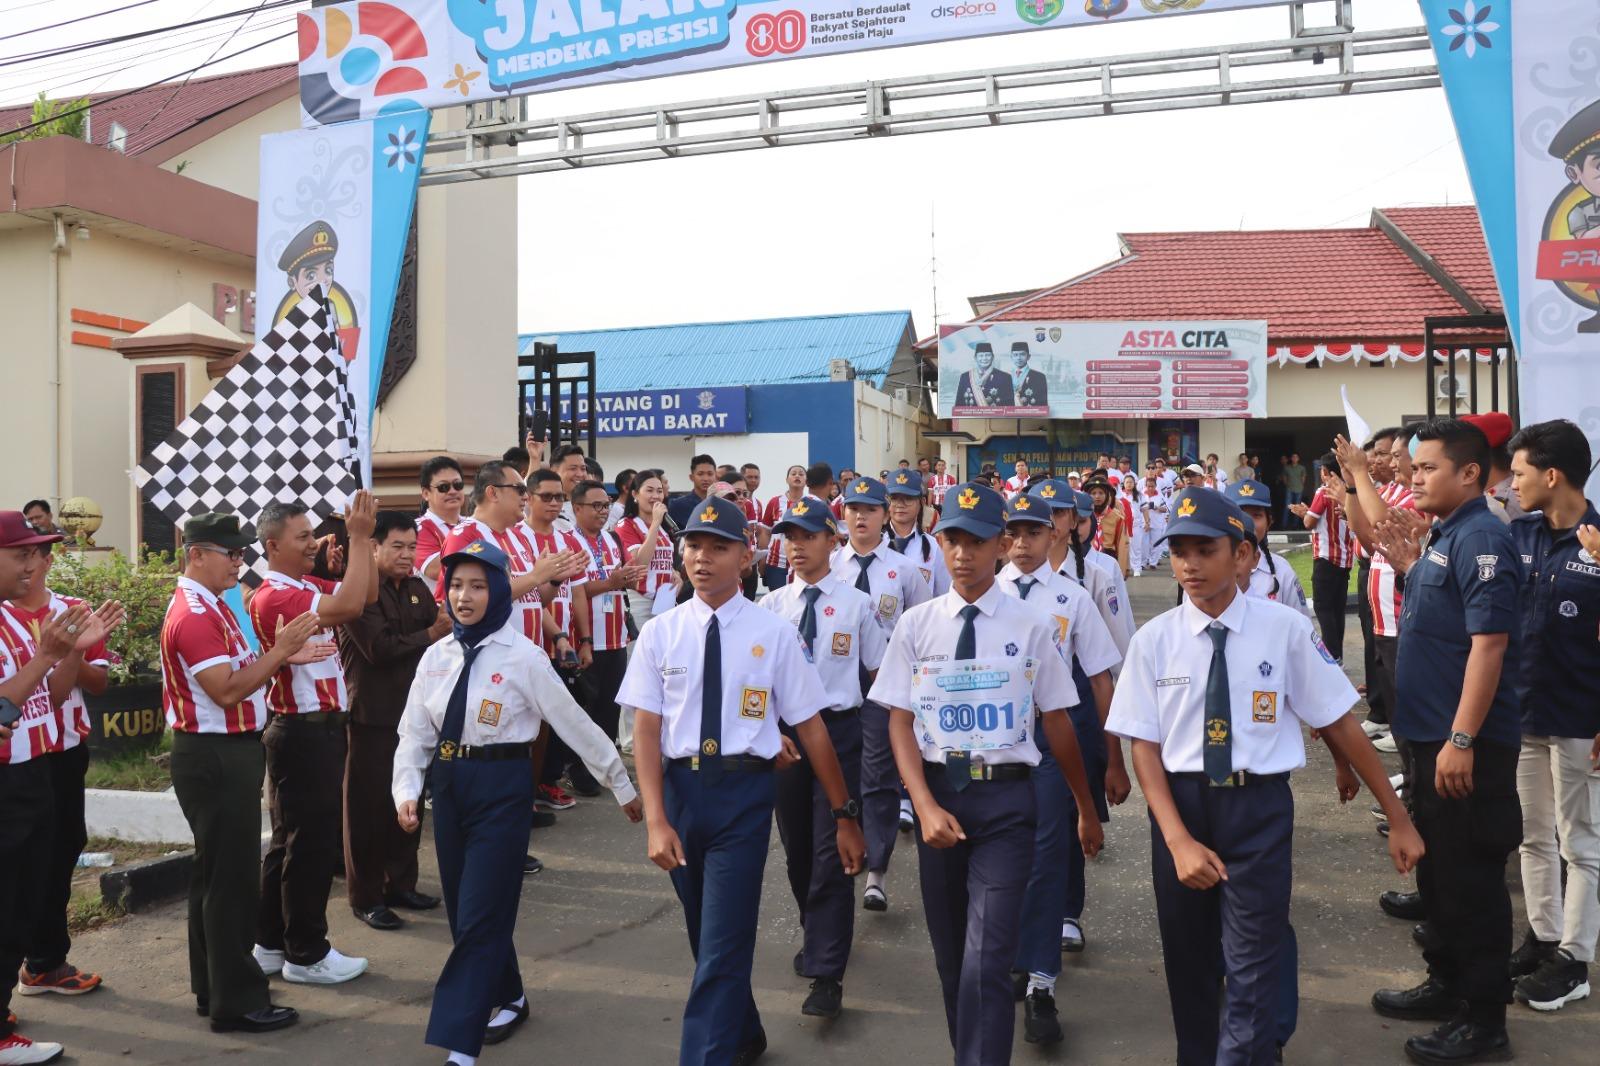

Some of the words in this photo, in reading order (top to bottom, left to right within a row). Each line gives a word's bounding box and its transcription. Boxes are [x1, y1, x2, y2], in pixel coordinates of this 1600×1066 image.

[810, 10, 854, 22] Bersatu
[857, 2, 911, 17] Berdaulat
[931, 1, 997, 18] dispora
[746, 9, 806, 57] 80
[811, 22, 848, 35] Rakyat
[851, 15, 905, 30] Sejahtera
[497, 38, 611, 76] MERDEKA
[619, 16, 718, 52] PRESISI
[811, 32, 865, 45] Indonesia
[868, 28, 893, 39] Maju
[1561, 250, 1600, 267] PR
[1120, 330, 1177, 348] ASTA
[1182, 330, 1229, 348] CITA
[661, 394, 680, 409] DI
[599, 415, 655, 432] KUTAI
[664, 413, 728, 430] BARAT
[939, 701, 1014, 733] 8001
